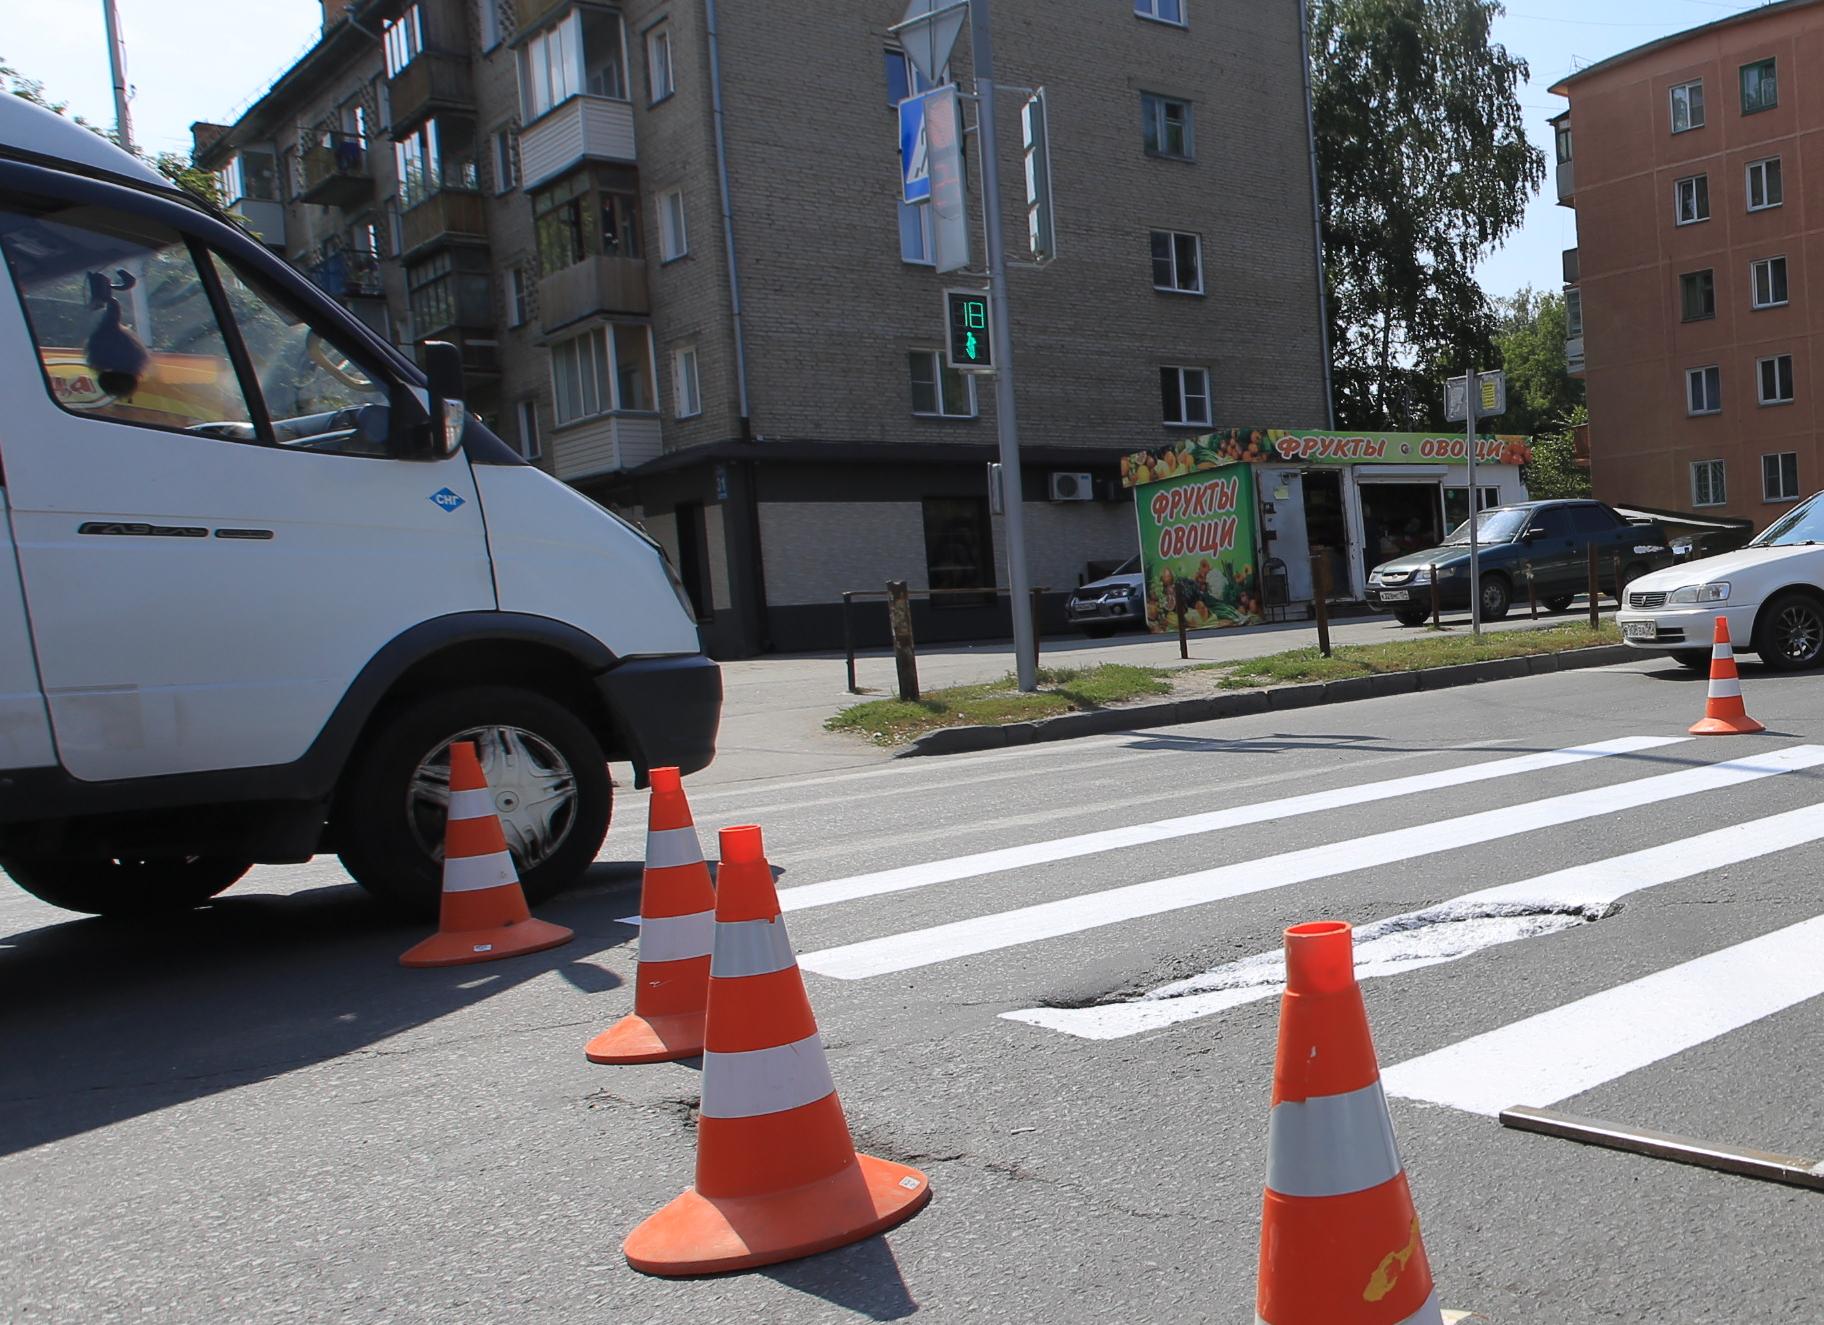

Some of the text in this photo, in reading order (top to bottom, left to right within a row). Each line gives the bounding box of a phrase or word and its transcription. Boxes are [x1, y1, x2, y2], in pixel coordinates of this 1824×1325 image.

[964, 301, 984, 328] 18
[1276, 435, 1505, 462] ФРУКТЫ ОВОЩИ
[436, 494, 459, 506] СНГ
[1151, 475, 1238, 525] ФРУКТЫ
[1159, 515, 1238, 559] ОВОЩИ
